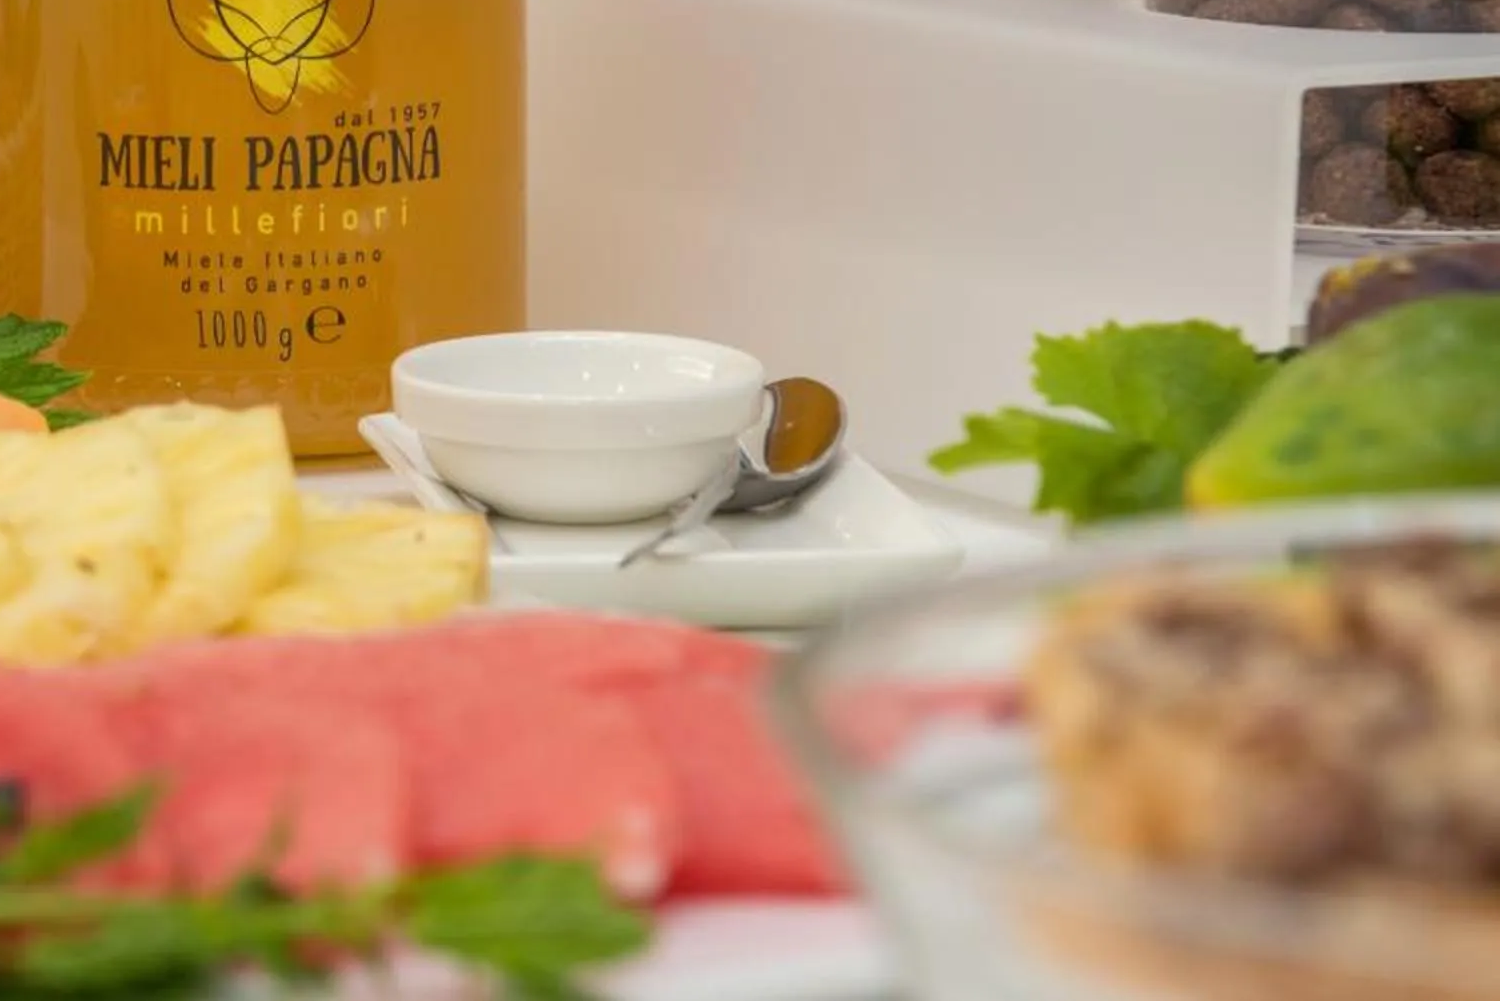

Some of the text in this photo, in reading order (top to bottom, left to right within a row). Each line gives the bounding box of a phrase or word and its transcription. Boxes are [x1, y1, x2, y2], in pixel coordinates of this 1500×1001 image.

[334, 103, 441, 127] dal 1957
[97, 125, 441, 191] MIELI PAPAGNA
[135, 199, 408, 234] millefiori
[164, 248, 382, 269] Miele Italiano
[181, 275, 367, 295] del Gargano
